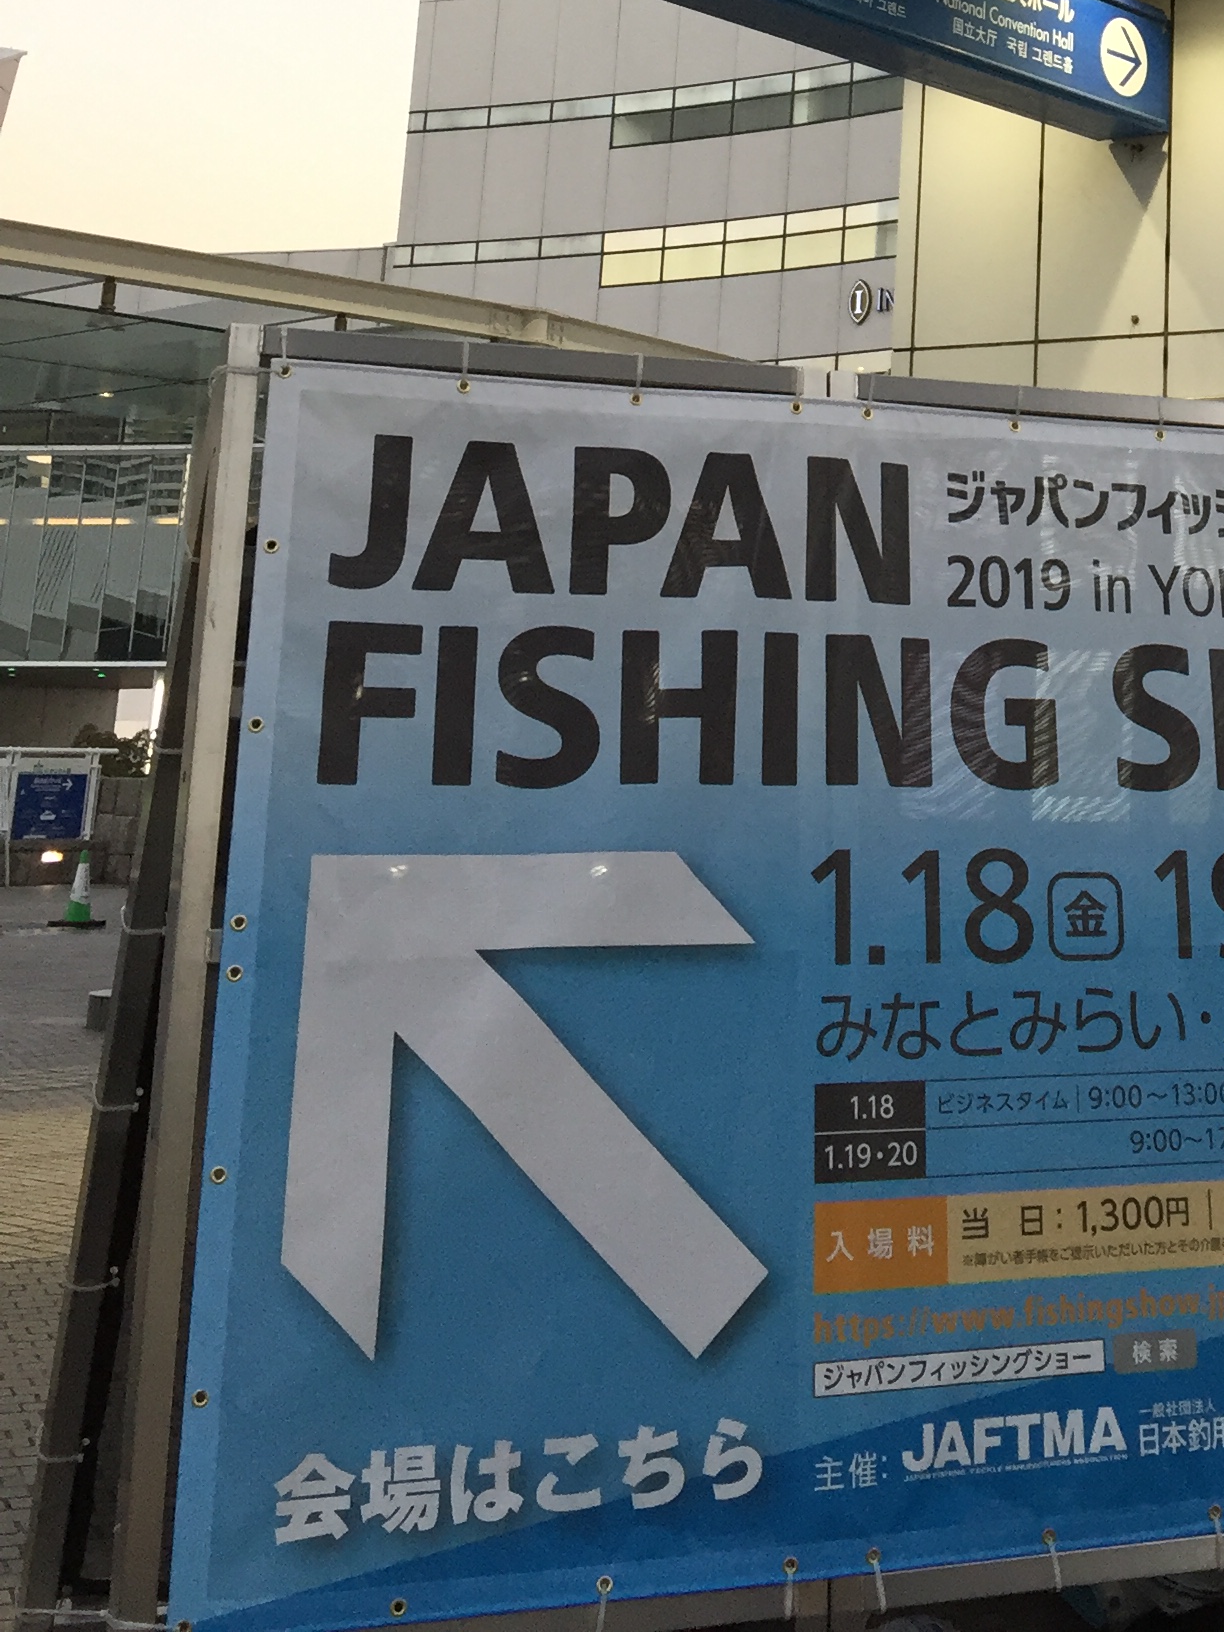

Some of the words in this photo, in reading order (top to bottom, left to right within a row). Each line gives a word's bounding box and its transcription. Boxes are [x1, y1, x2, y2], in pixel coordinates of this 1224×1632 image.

[952, 16, 998, 48] 国立大厅
[989, 7, 1050, 43] Convention
[1052, 28, 1074, 52] Hall
[327, 434, 911, 605] JAPAN
[946, 554, 1072, 612] 2019
[1093, 558, 1131, 615] in
[316, 620, 1059, 791] FISHING
[810, 848, 1036, 967] 1.18
[1063, 888, 1110, 940] 金
[850, 1094, 894, 1120] 1.18
[938, 1089, 1067, 1115] ビジネスタイム
[823, 1348, 1093, 1392] ジャパンフィッシングショー
[1132, 1338, 1178, 1365] 検索
[1139, 1398, 1216, 1418] 一般社団法人
[902, 1406, 1127, 1472] JAFTMA
[273, 1416, 767, 1546] 会場はこちら
